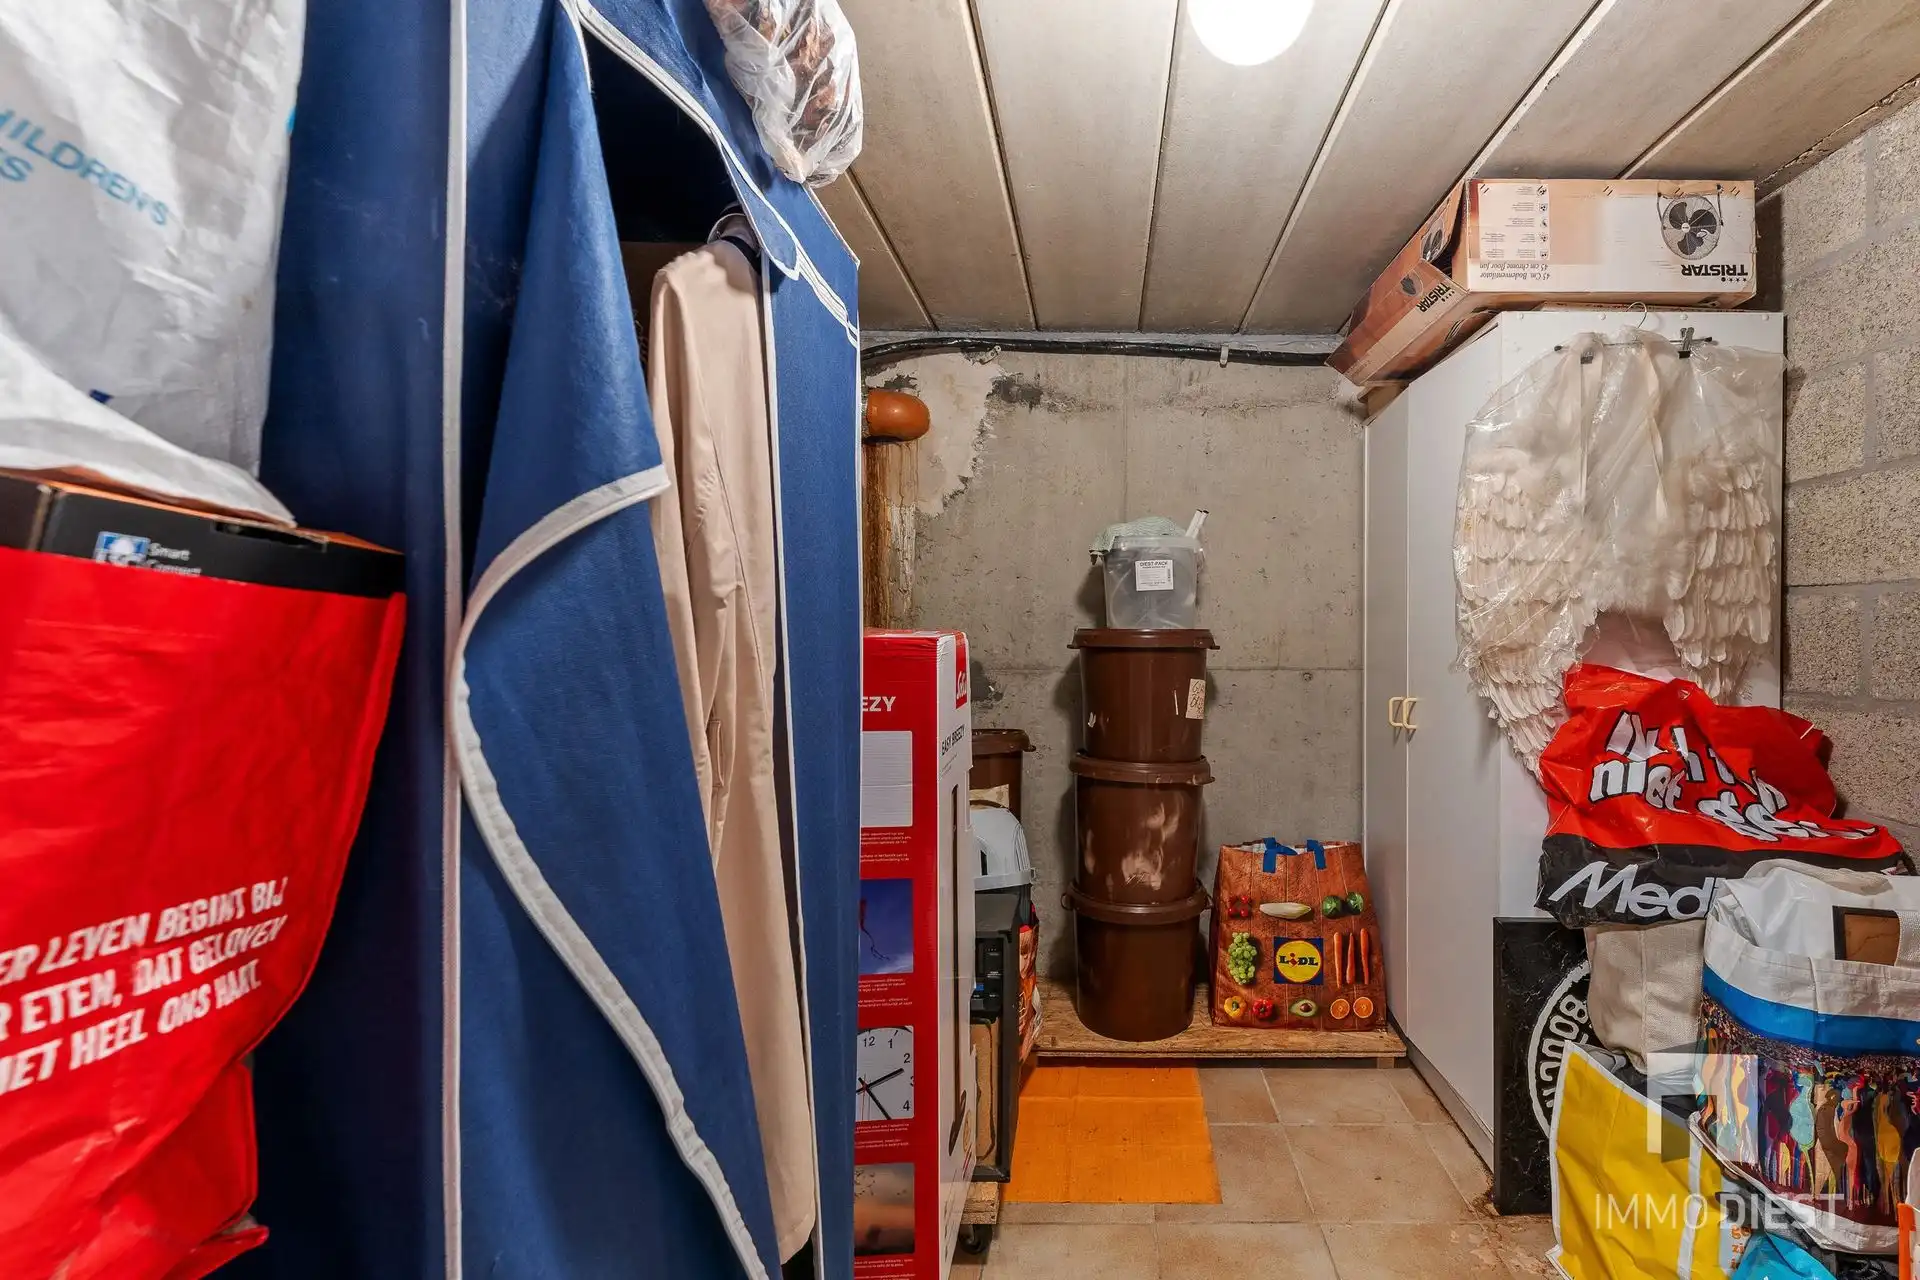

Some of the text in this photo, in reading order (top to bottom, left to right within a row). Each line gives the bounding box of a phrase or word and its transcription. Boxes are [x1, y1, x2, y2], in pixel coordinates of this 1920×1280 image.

[1680, 264, 1748, 282] TRISTAR
[1415, 282, 1452, 313] TRISTAR
[36, 911, 151, 975] LEVEN
[154, 886, 247, 943] BEGINT
[250, 875, 289, 914] BIJ
[132, 946, 184, 997] DAT
[188, 914, 289, 975] GELOVEN
[69, 1007, 149, 1071] HEEL
[157, 983, 211, 1034] ONS
[862, 1035, 876, 1048] 12
[887, 1038, 893, 1049] 1
[903, 1052, 911, 1064] 2
[902, 1099, 911, 1112] 4
